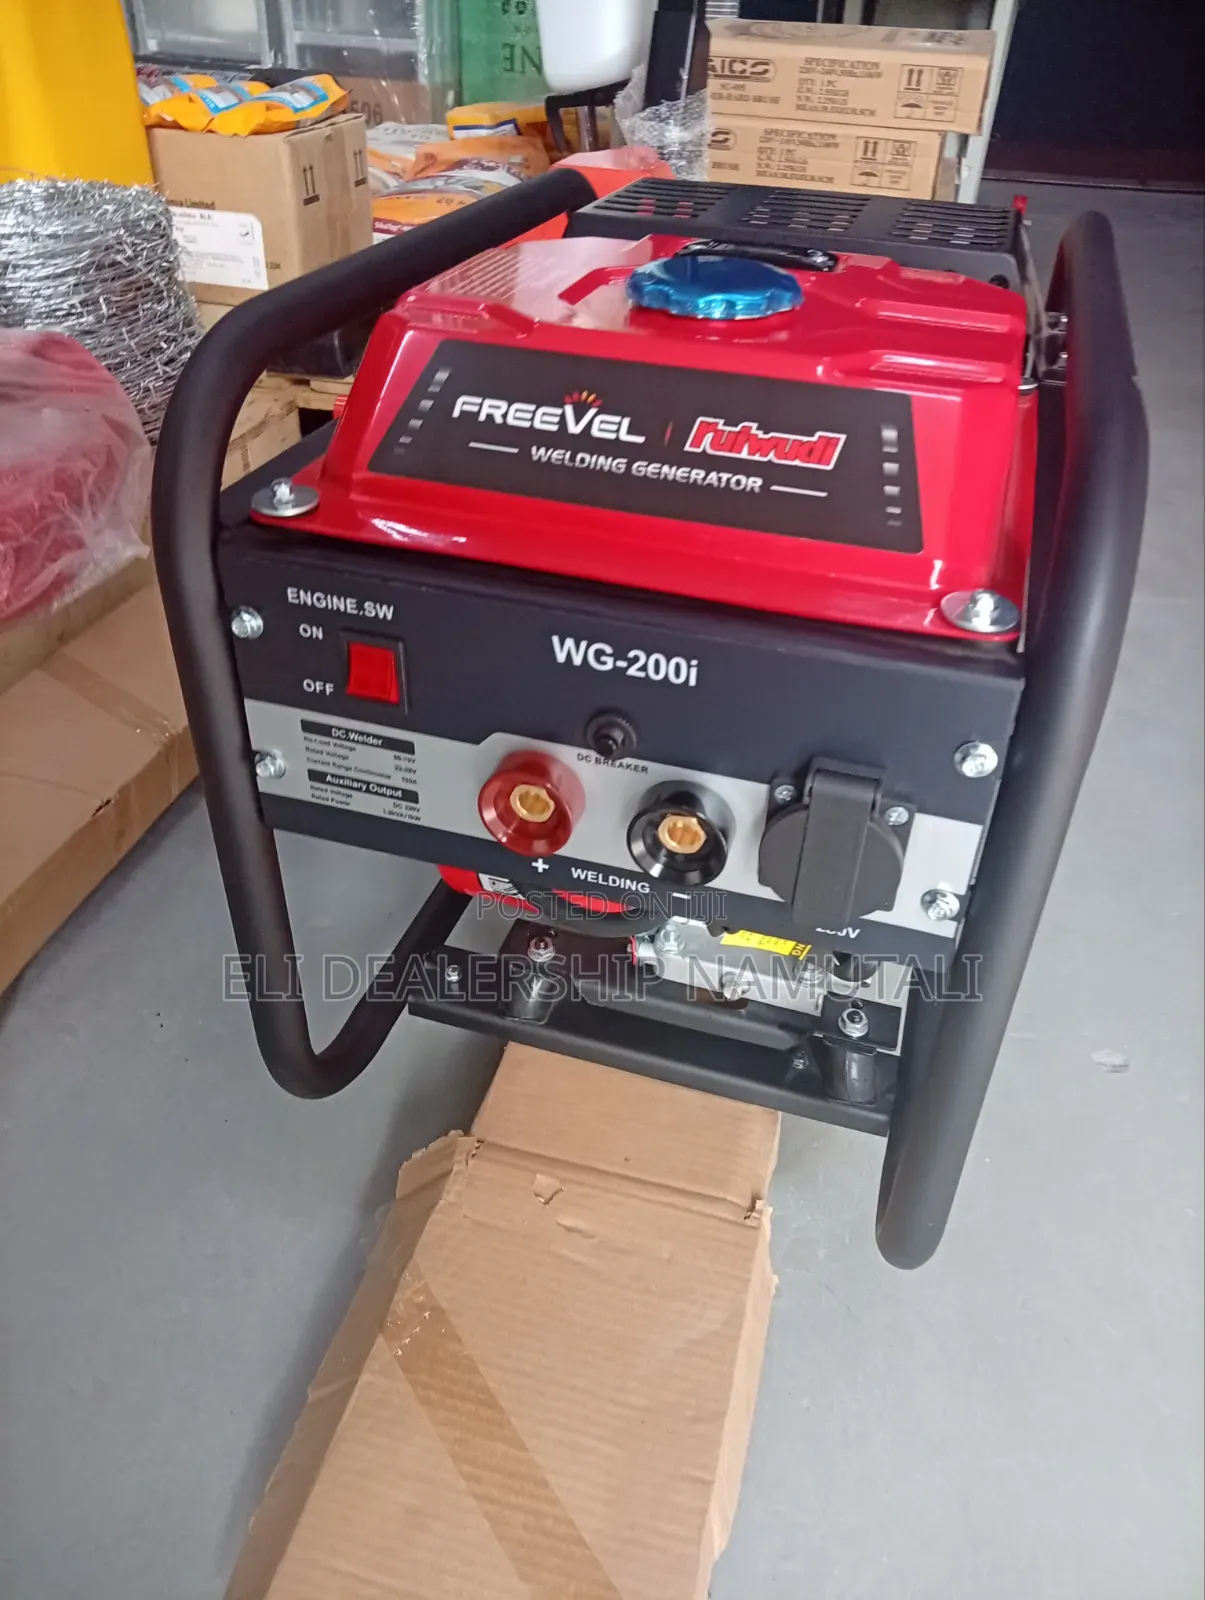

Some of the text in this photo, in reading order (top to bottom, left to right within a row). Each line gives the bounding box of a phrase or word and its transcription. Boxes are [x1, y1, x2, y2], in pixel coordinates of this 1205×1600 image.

[803, 57, 882, 71] SPECIFICATION
[764, 128, 838, 141] SPECIFICATION
[452, 394, 646, 444] FREEVEL
[530, 444, 763, 494] WELDING GENERATOR
[287, 586, 394, 621] ENGINE.SW
[299, 623, 323, 640] ON
[551, 634, 698, 687] WG-200i
[303, 679, 334, 696] OFF
[576, 752, 650, 775] DC BREAKER
[325, 773, 403, 798] Auxiliary Output
[570, 866, 650, 895] WELDING
